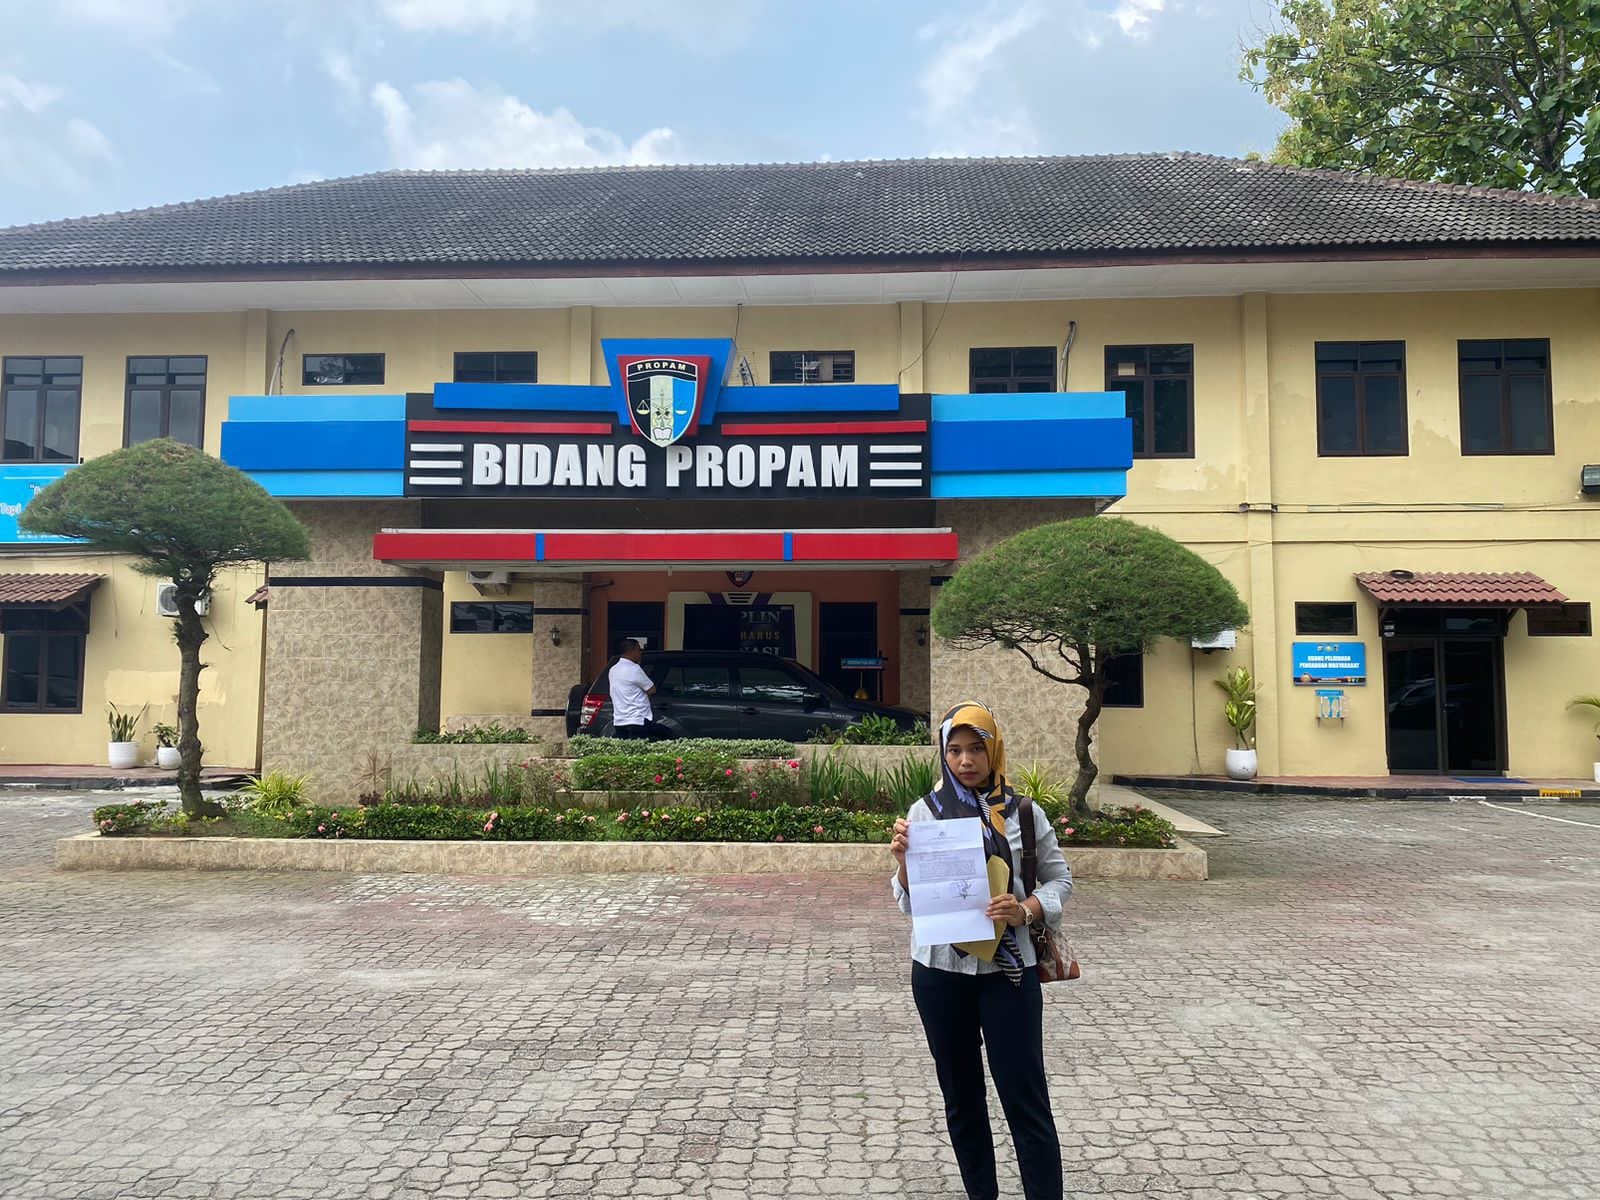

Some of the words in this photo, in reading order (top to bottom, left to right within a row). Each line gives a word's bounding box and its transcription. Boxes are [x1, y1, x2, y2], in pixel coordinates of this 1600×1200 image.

[637, 362, 686, 371] PROPAM
[473, 444, 647, 487] BIDANG
[666, 444, 859, 487] PROPAM
